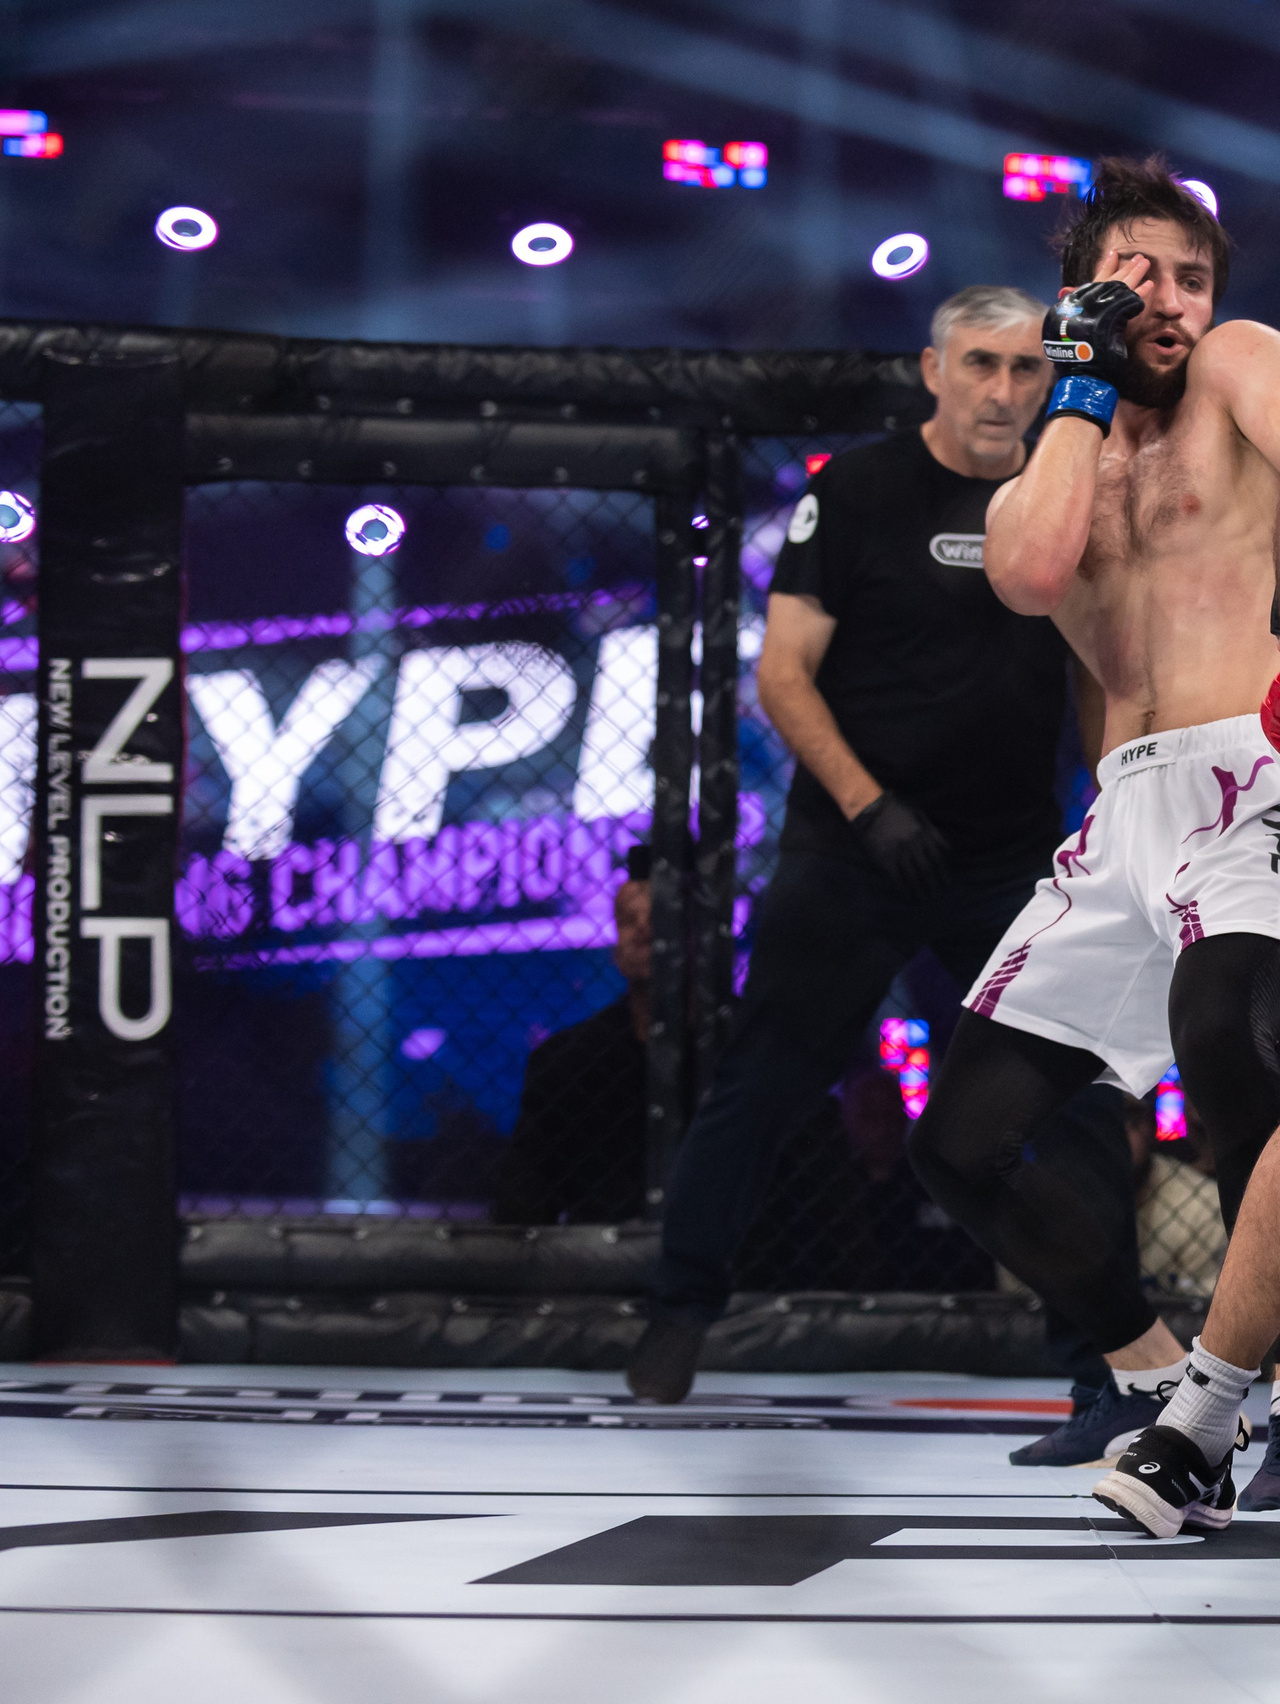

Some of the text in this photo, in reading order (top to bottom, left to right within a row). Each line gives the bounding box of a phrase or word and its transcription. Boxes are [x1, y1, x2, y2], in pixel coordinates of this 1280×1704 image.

[1044, 345, 1074, 358] Winline
[44, 658, 72, 1041] NEW LEVEL PRODUCTION
[80, 657, 174, 1042] NLP
[1121, 742, 1158, 766] HYPE
